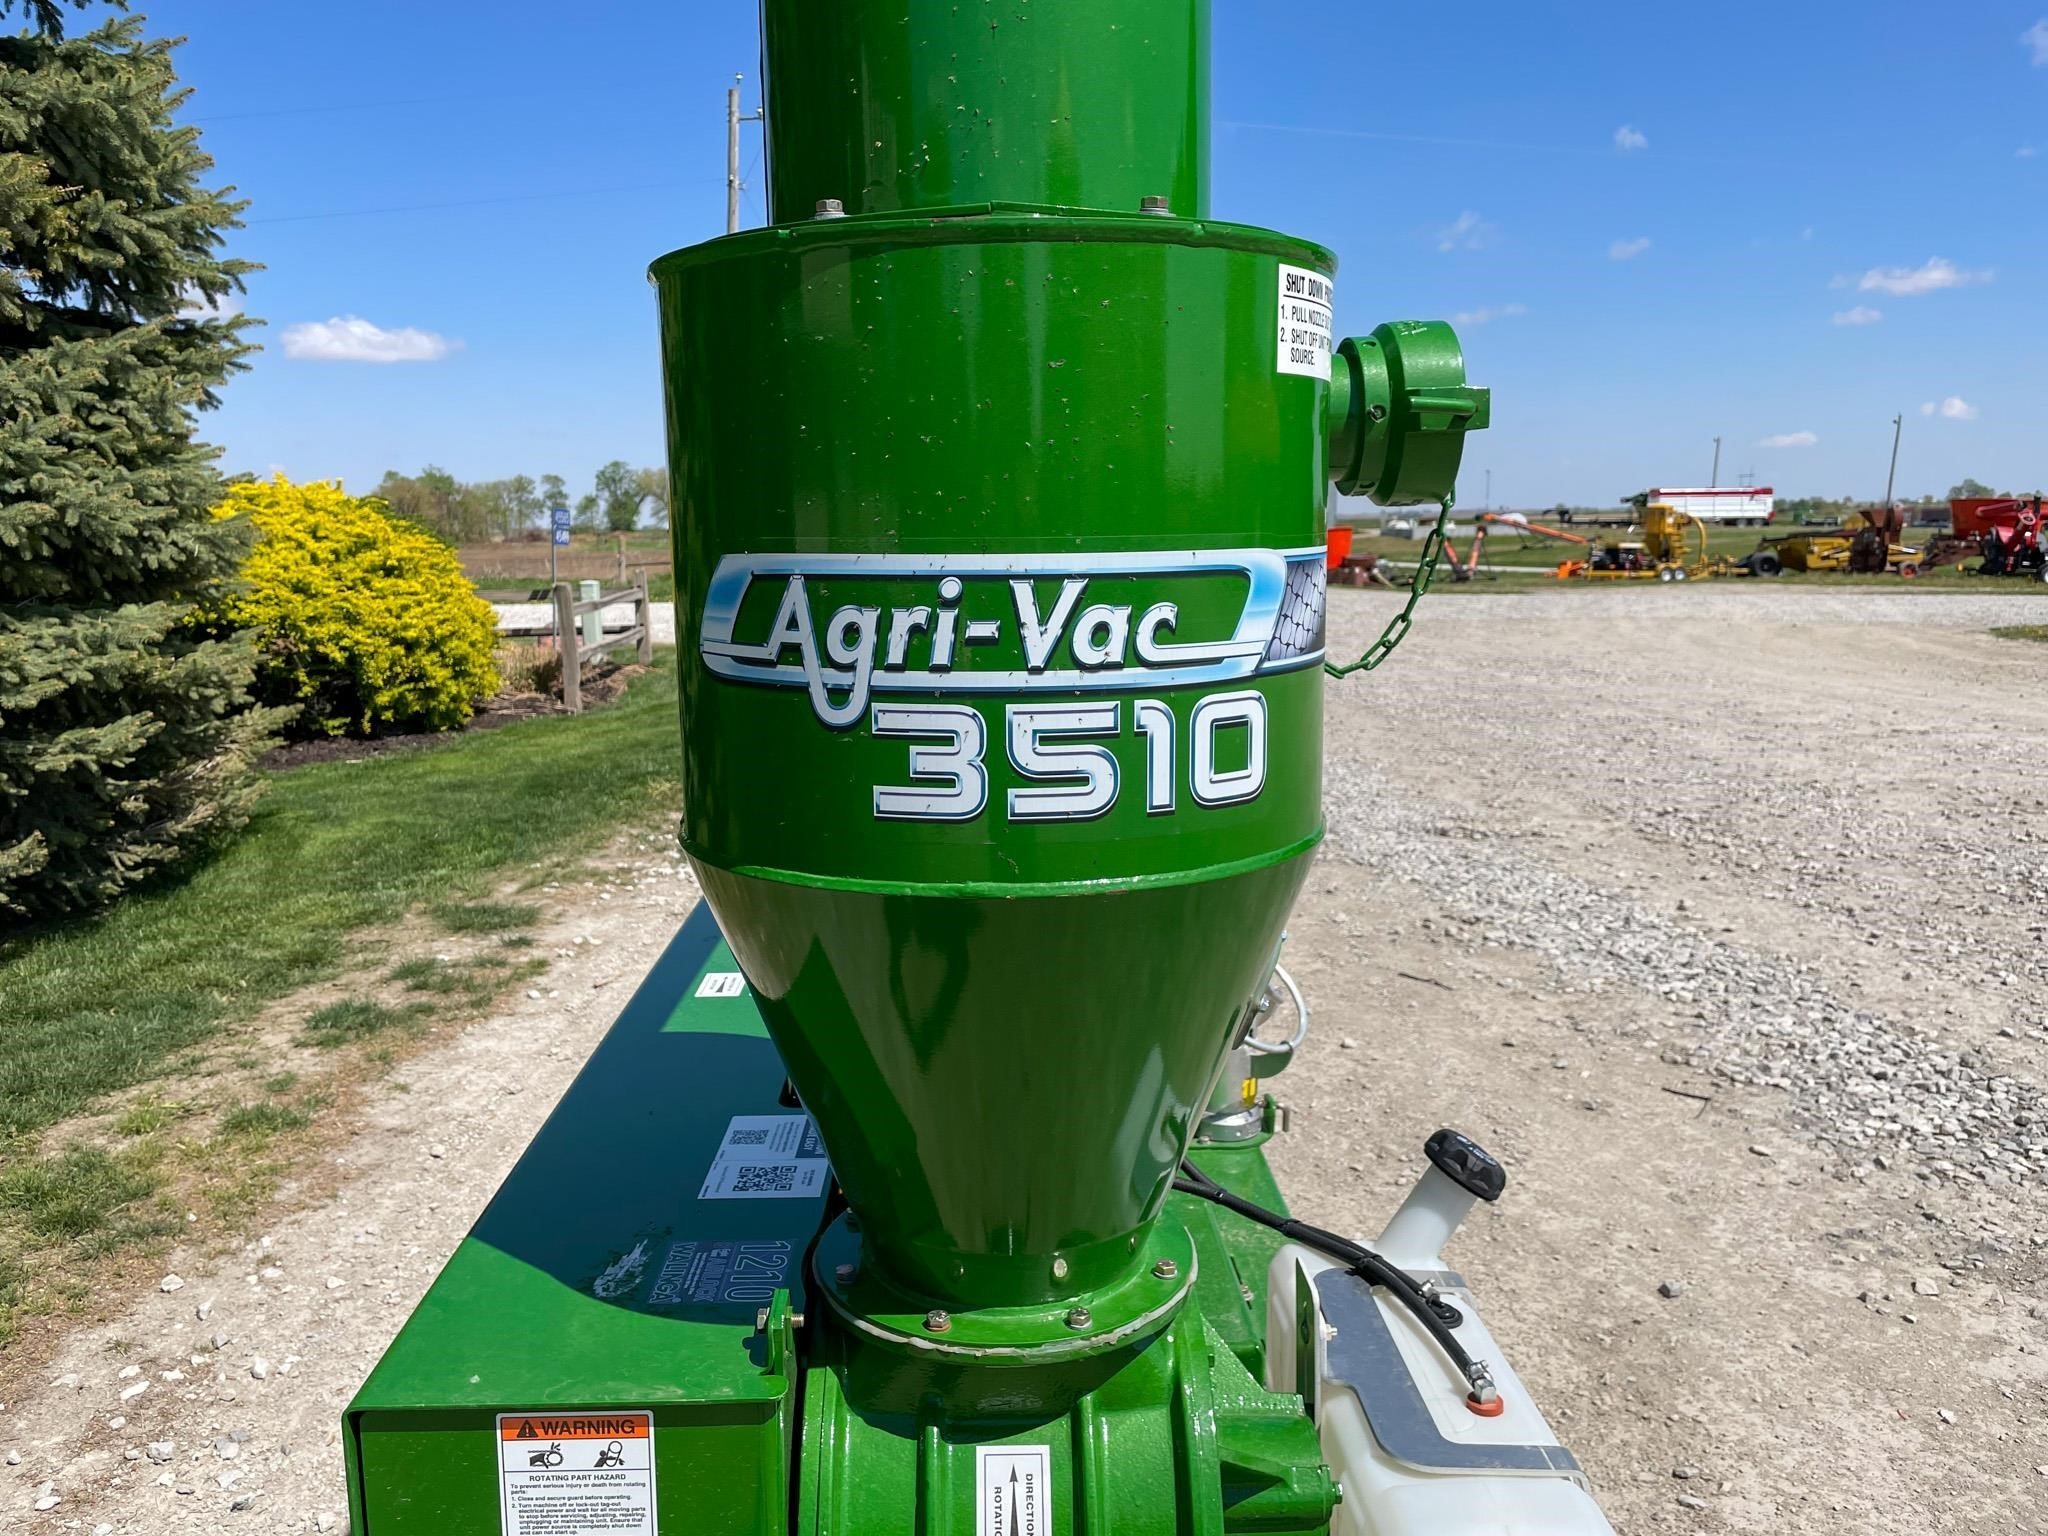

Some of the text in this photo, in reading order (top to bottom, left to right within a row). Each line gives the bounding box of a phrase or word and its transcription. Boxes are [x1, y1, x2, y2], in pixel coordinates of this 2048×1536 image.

[1286, 273, 1305, 294] SHUT
[1308, 278, 1323, 299] DOWN
[1281, 304, 1288, 320] 1.
[1291, 305, 1307, 323] PULL
[1280, 327, 1287, 342] 2.
[1291, 328, 1308, 346] SHUT
[1308, 331, 1318, 348] OFF
[1290, 347, 1315, 366] SOURCE.
[760, 574, 1180, 727] Agri-Vac
[872, 690, 1268, 822] 3510
[648, 1242, 697, 1304] WALINGA
[724, 1240, 792, 1302] 1210
[540, 1419, 635, 1436] WARNING
[593, 1473, 626, 1481] HAZARD
